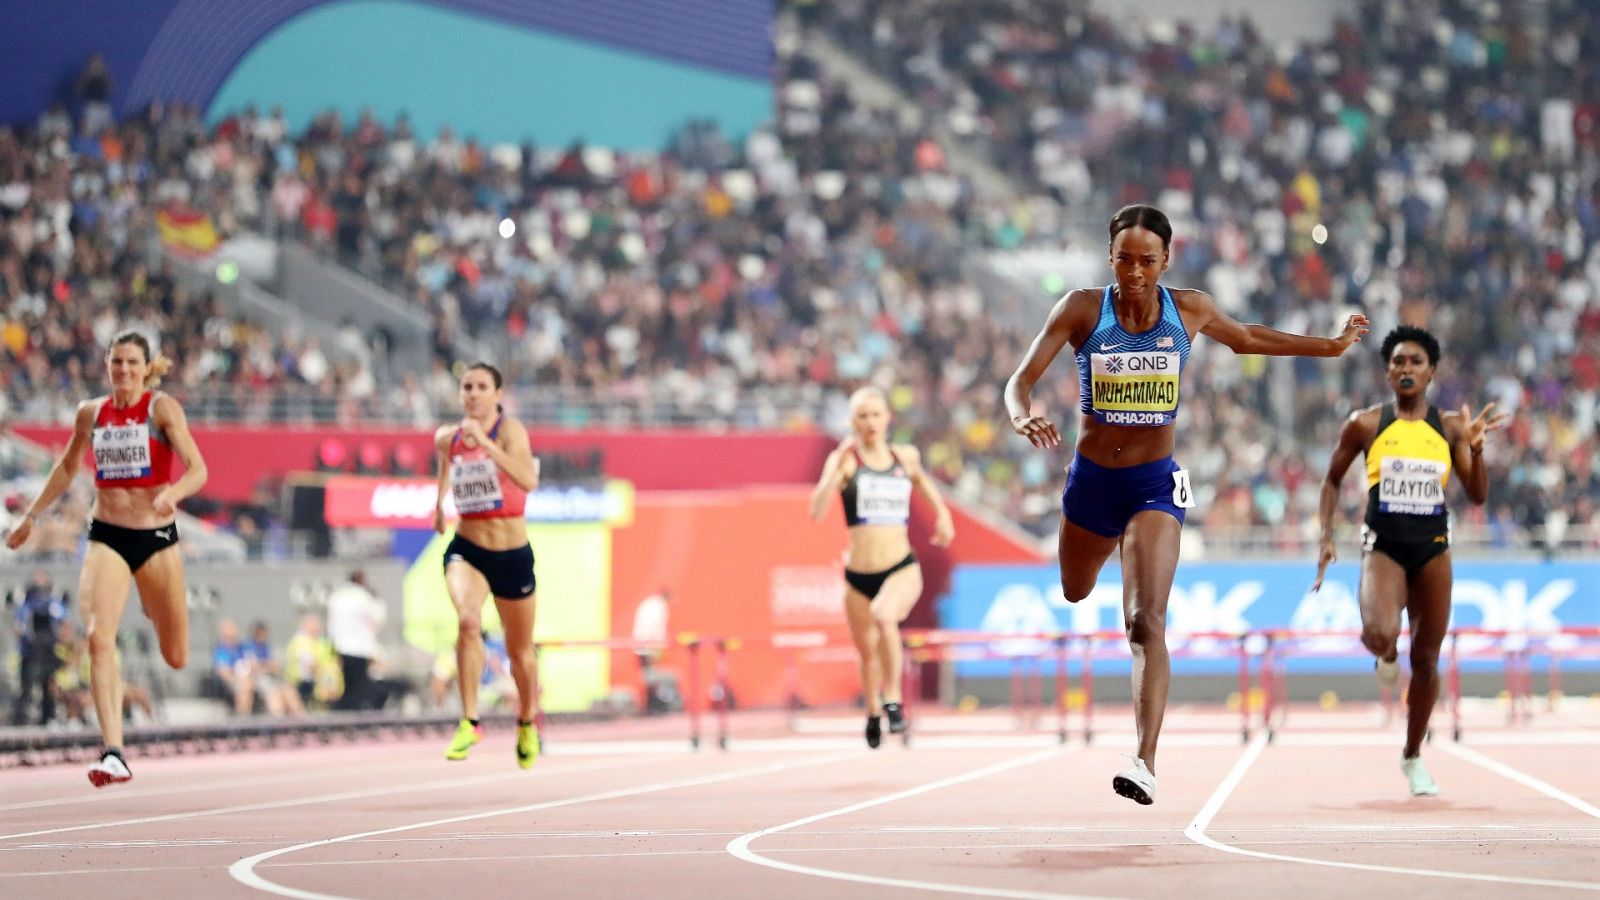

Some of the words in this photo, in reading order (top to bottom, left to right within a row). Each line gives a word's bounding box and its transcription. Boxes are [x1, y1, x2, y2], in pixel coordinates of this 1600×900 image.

[1127, 356, 1168, 371] QNB
[1094, 381, 1174, 404] MUHAMMAD
[1106, 412, 1164, 424] DOHA2019
[95, 446, 146, 466] SPRUNGER
[1180, 476, 1187, 503] 6
[1382, 477, 1440, 498] CLAYTON
[1046, 579, 1264, 652] TK
